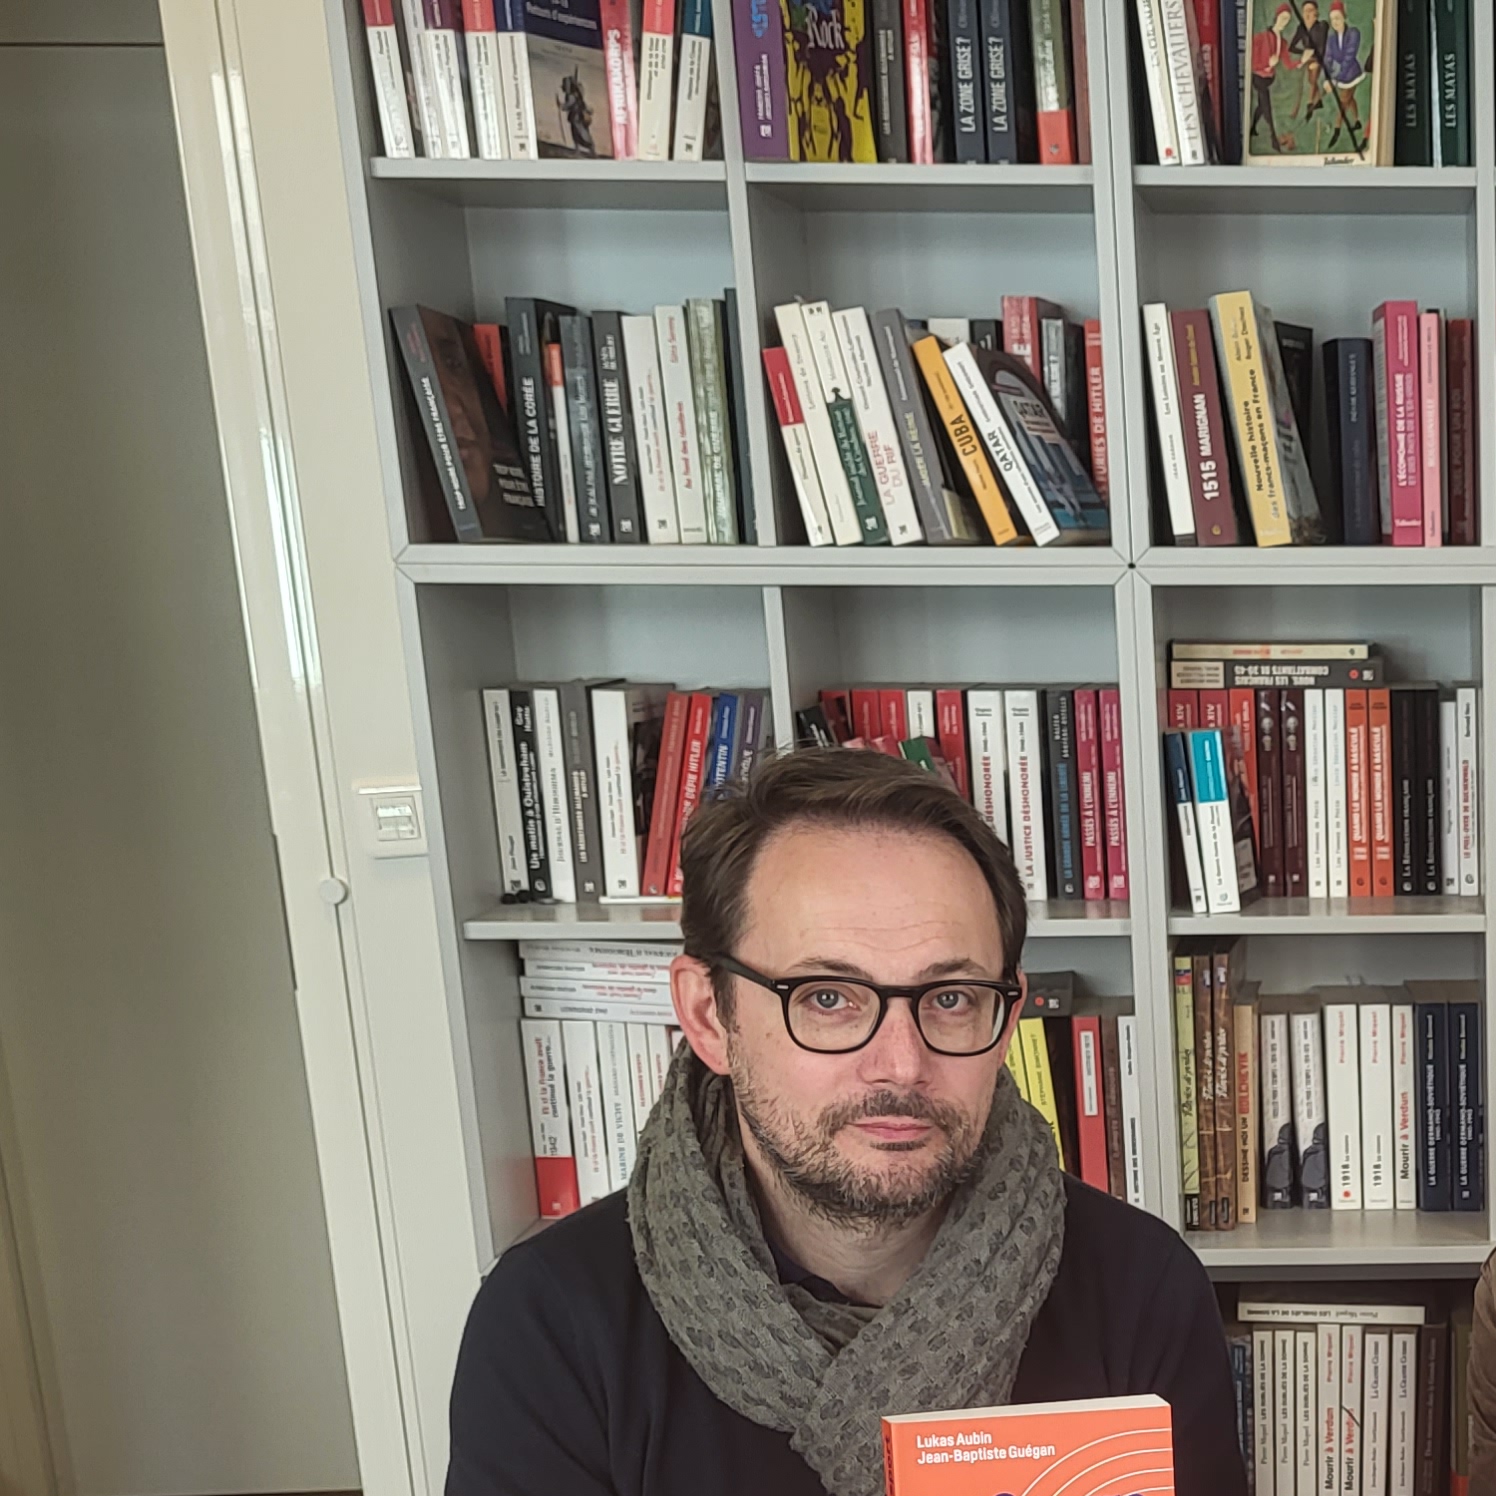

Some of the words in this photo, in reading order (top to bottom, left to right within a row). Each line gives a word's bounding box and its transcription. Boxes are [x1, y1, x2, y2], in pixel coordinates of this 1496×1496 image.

[608, 29, 628, 125] AFRIKAKORPS
[956, 37, 972, 79] GRISE?
[959, 82, 974, 113] ZONE
[959, 116, 975, 132] LA
[1247, 369, 1259, 404] France
[1193, 394, 1212, 456] MARIGNAN
[1242, 401, 1255, 441] histoire
[1253, 407, 1262, 419] en
[950, 414, 977, 457] CUBA
[987, 430, 1013, 472] QATAR
[1200, 460, 1219, 500] 1515
[1247, 444, 1263, 491] Nouvelle
[1256, 423, 1277, 498] francs-maçons
[1398, 1092, 1410, 1130] Verdun
[1399, 1143, 1410, 1179] Mourir
[917, 1433, 955, 1449] Lukas
[956, 1432, 992, 1447] Aubin
[917, 1447, 1007, 1465] Jean-Baptiste
[1009, 1444, 1055, 1460] Guégan
